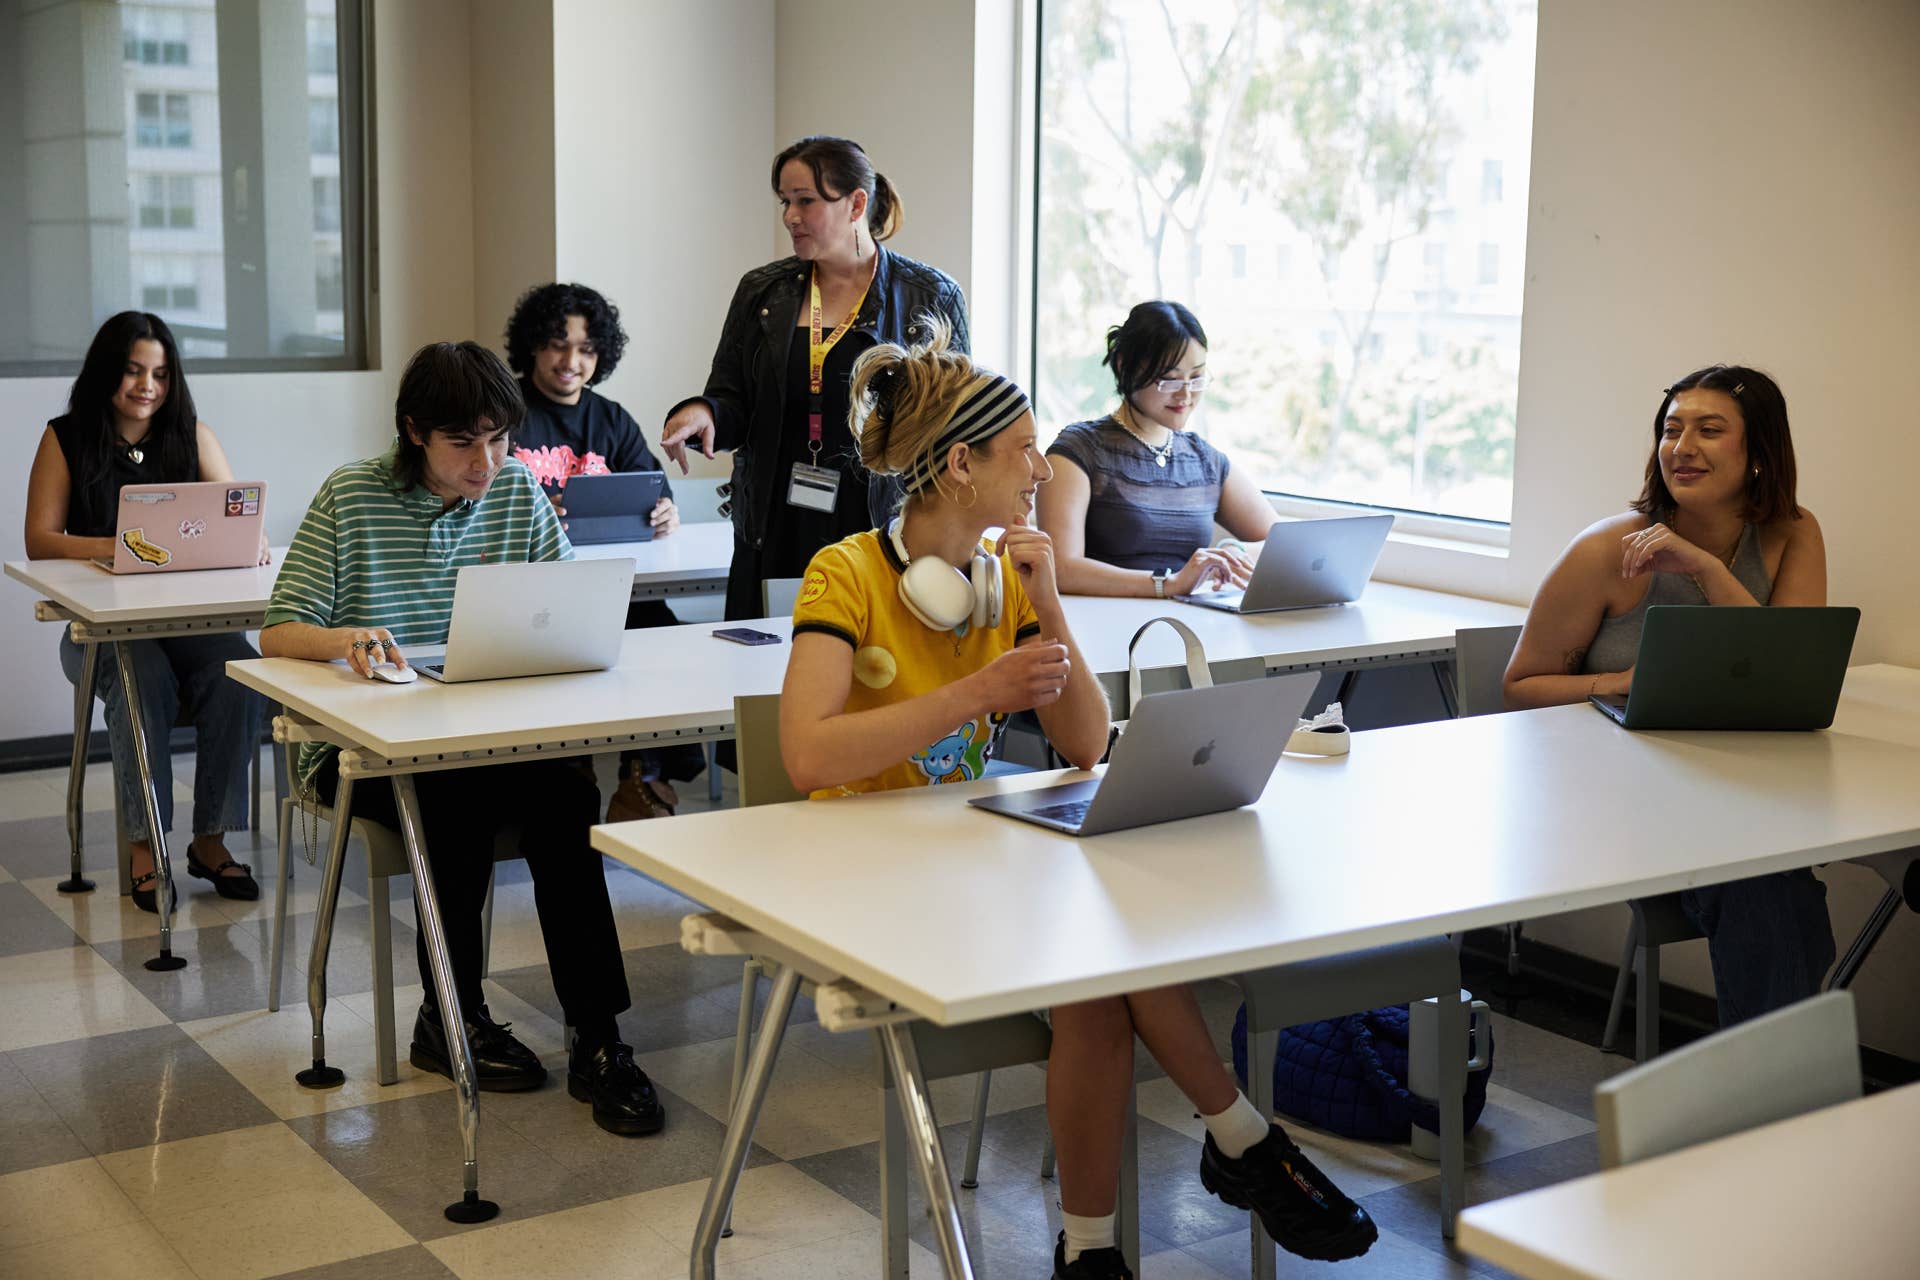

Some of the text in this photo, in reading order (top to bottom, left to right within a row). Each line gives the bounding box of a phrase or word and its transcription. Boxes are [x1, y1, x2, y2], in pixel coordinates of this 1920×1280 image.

[812, 306, 822, 346] SUN DEVILS
[825, 325, 847, 344] DEVILS
